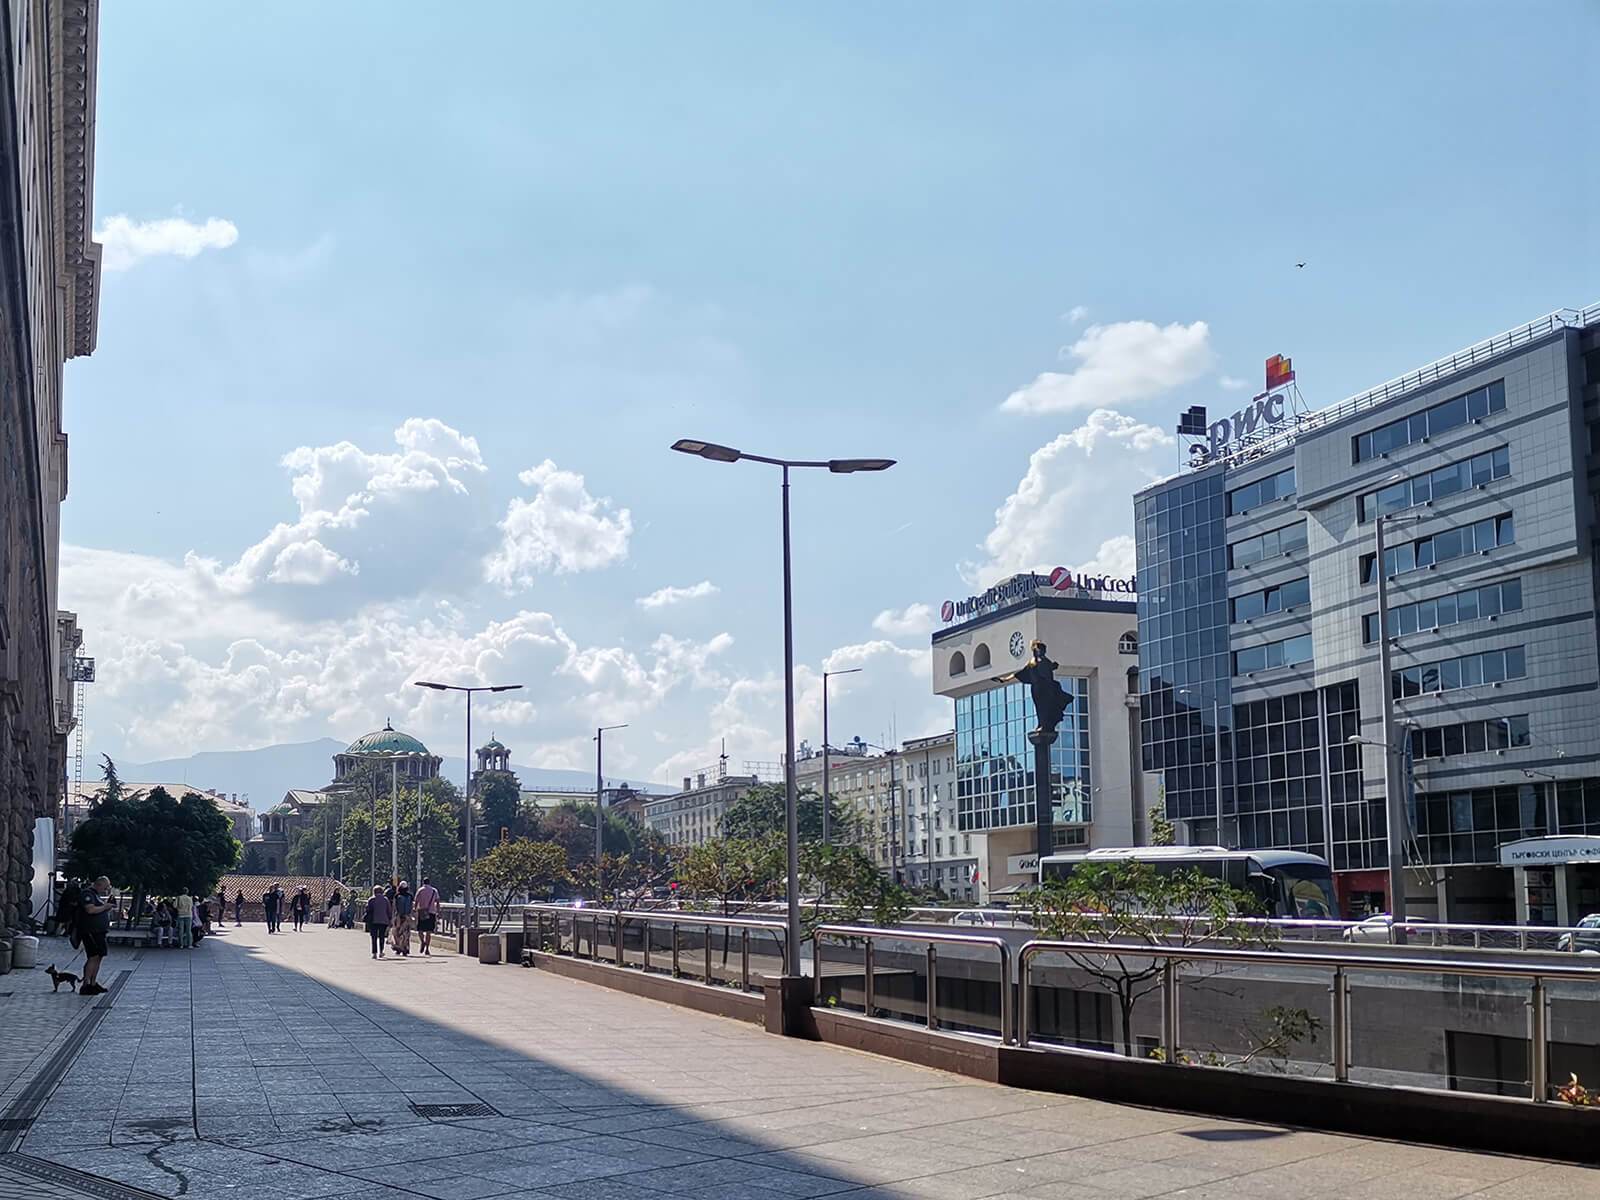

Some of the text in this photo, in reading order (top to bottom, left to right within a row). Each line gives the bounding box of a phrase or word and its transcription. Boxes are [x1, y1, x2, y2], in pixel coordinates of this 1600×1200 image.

[1206, 393, 1285, 460] pwc
[956, 571, 1040, 616] UniCredit Bulbank
